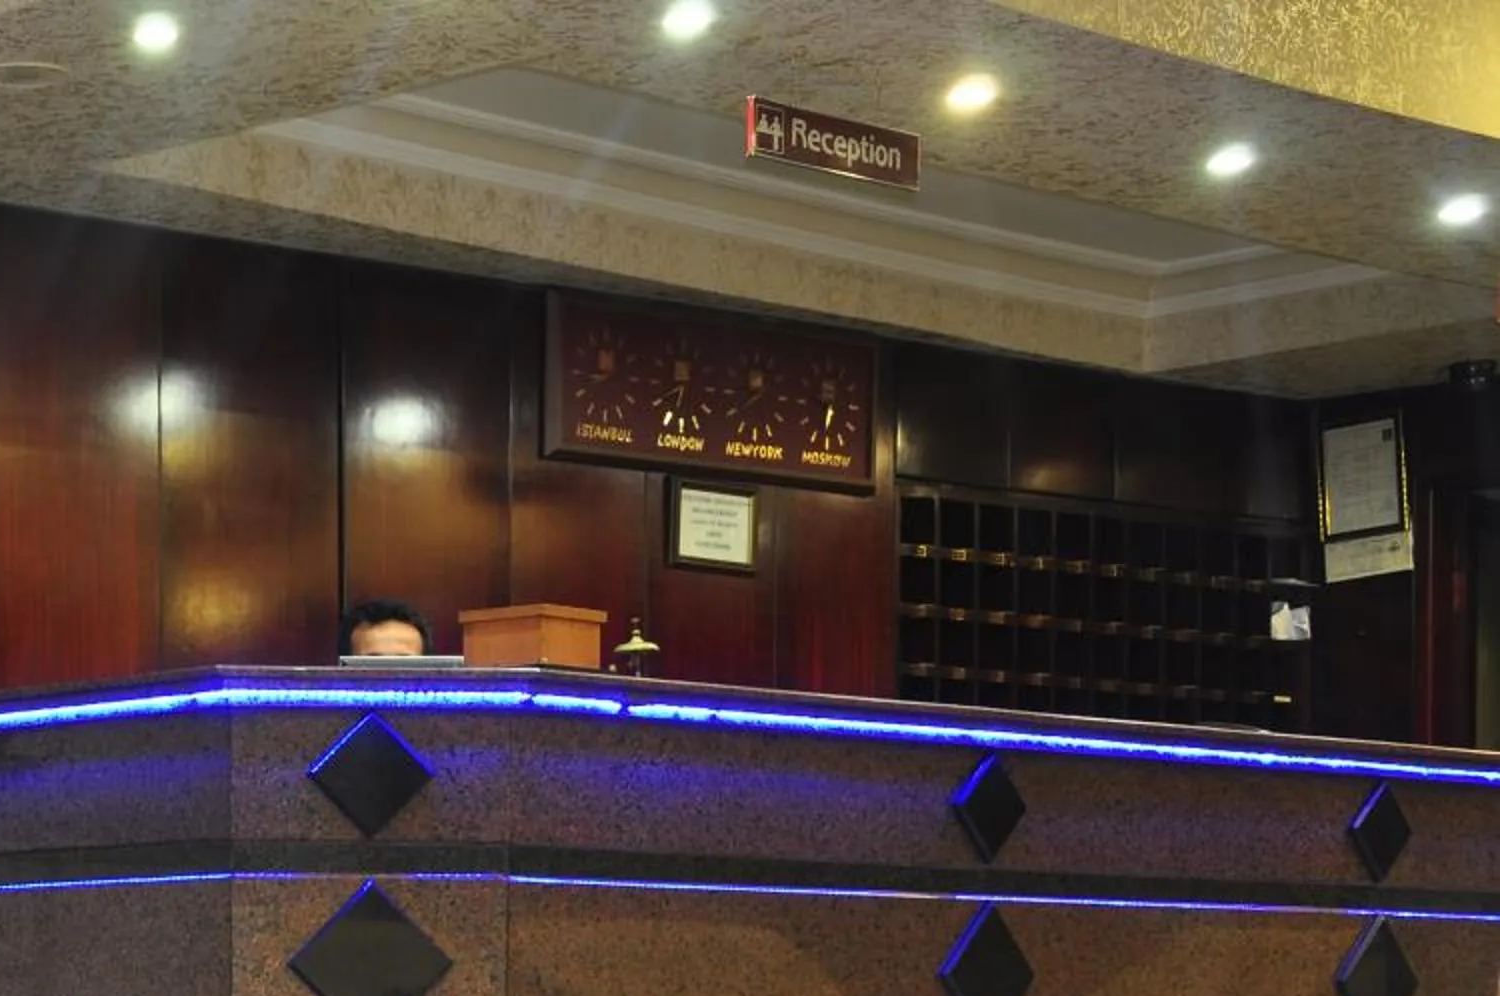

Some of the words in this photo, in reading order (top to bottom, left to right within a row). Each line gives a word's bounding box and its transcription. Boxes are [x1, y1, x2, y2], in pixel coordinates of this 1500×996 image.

[791, 117, 901, 170] Reception
[658, 432, 705, 452] LONDON
[802, 449, 852, 468] MOSKOW
